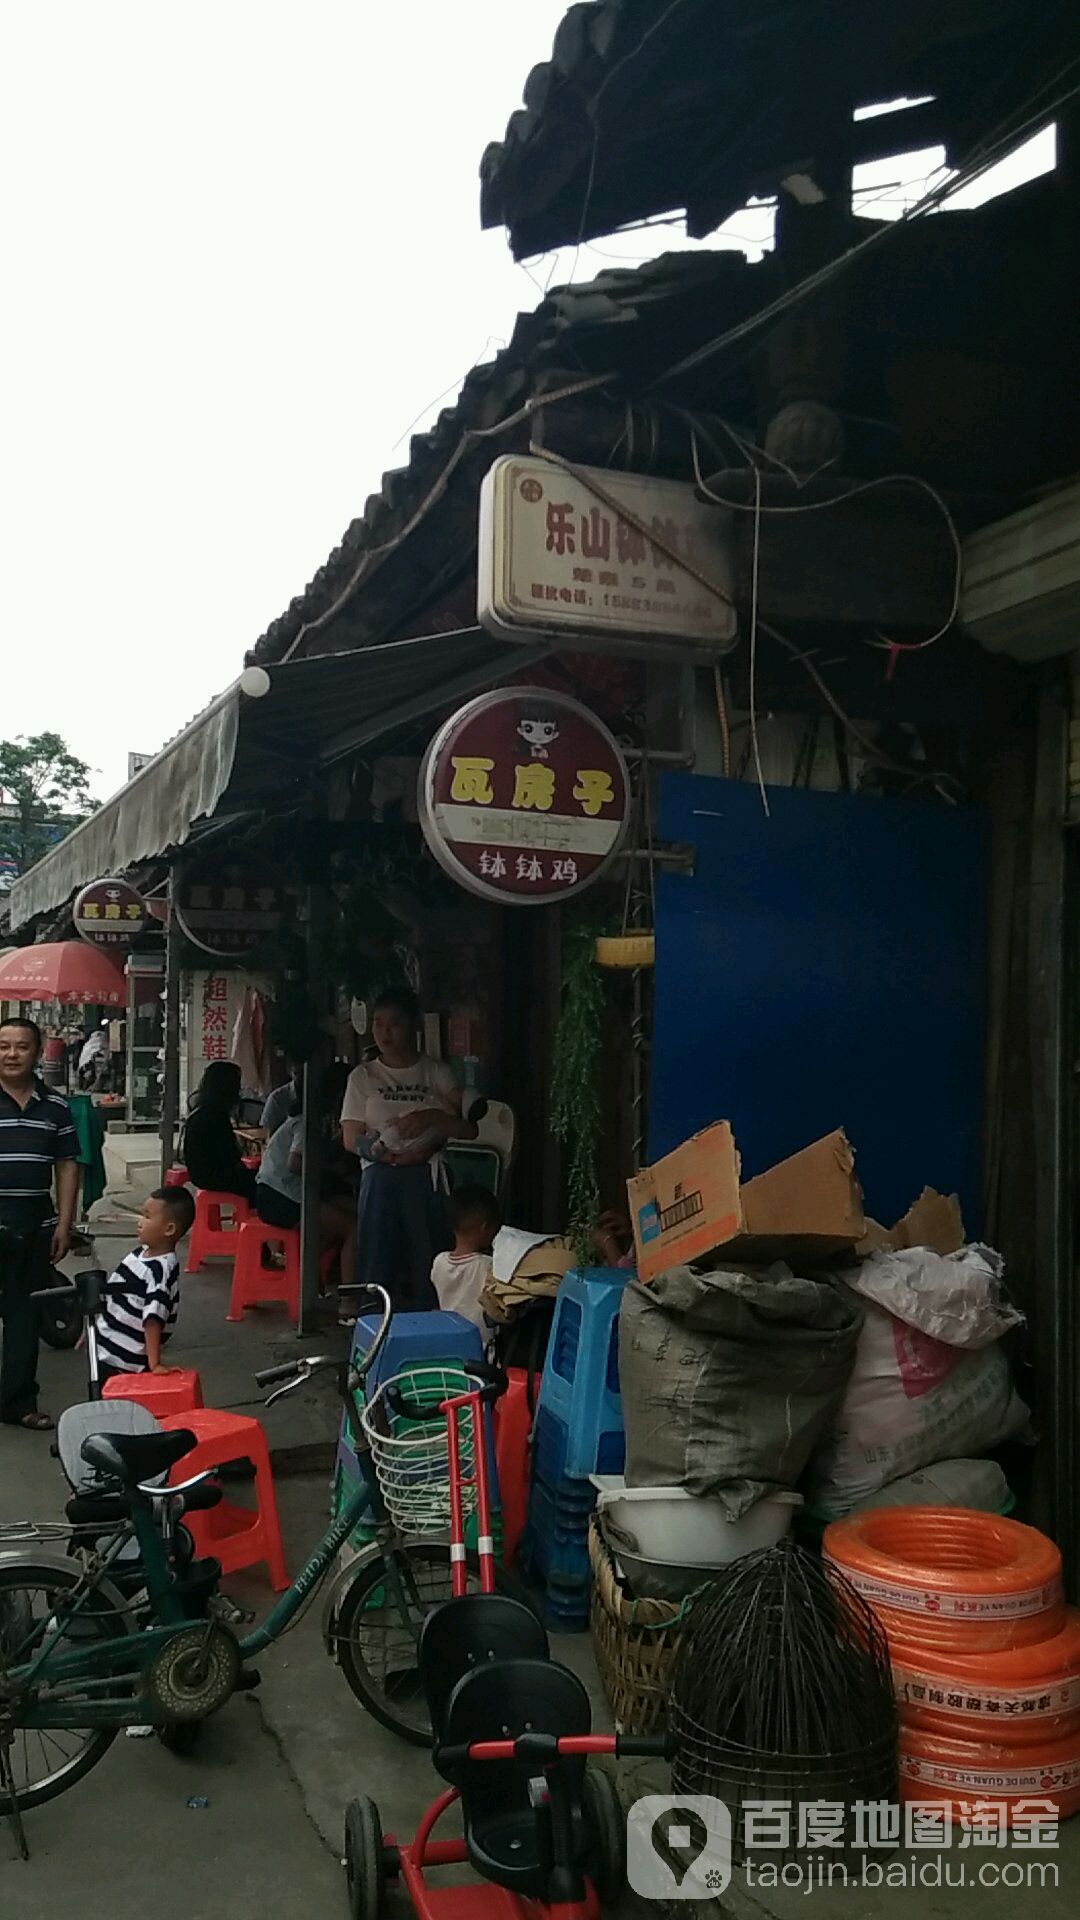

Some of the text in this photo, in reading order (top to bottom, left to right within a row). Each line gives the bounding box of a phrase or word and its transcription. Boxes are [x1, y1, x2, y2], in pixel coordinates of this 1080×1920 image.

[451, 756, 614, 815] 瓦房子
[479, 850, 578, 884] 钵钵鸡
[202, 976, 228, 1061] 超然鞋
[325, 1515, 351, 1550] BIKE
